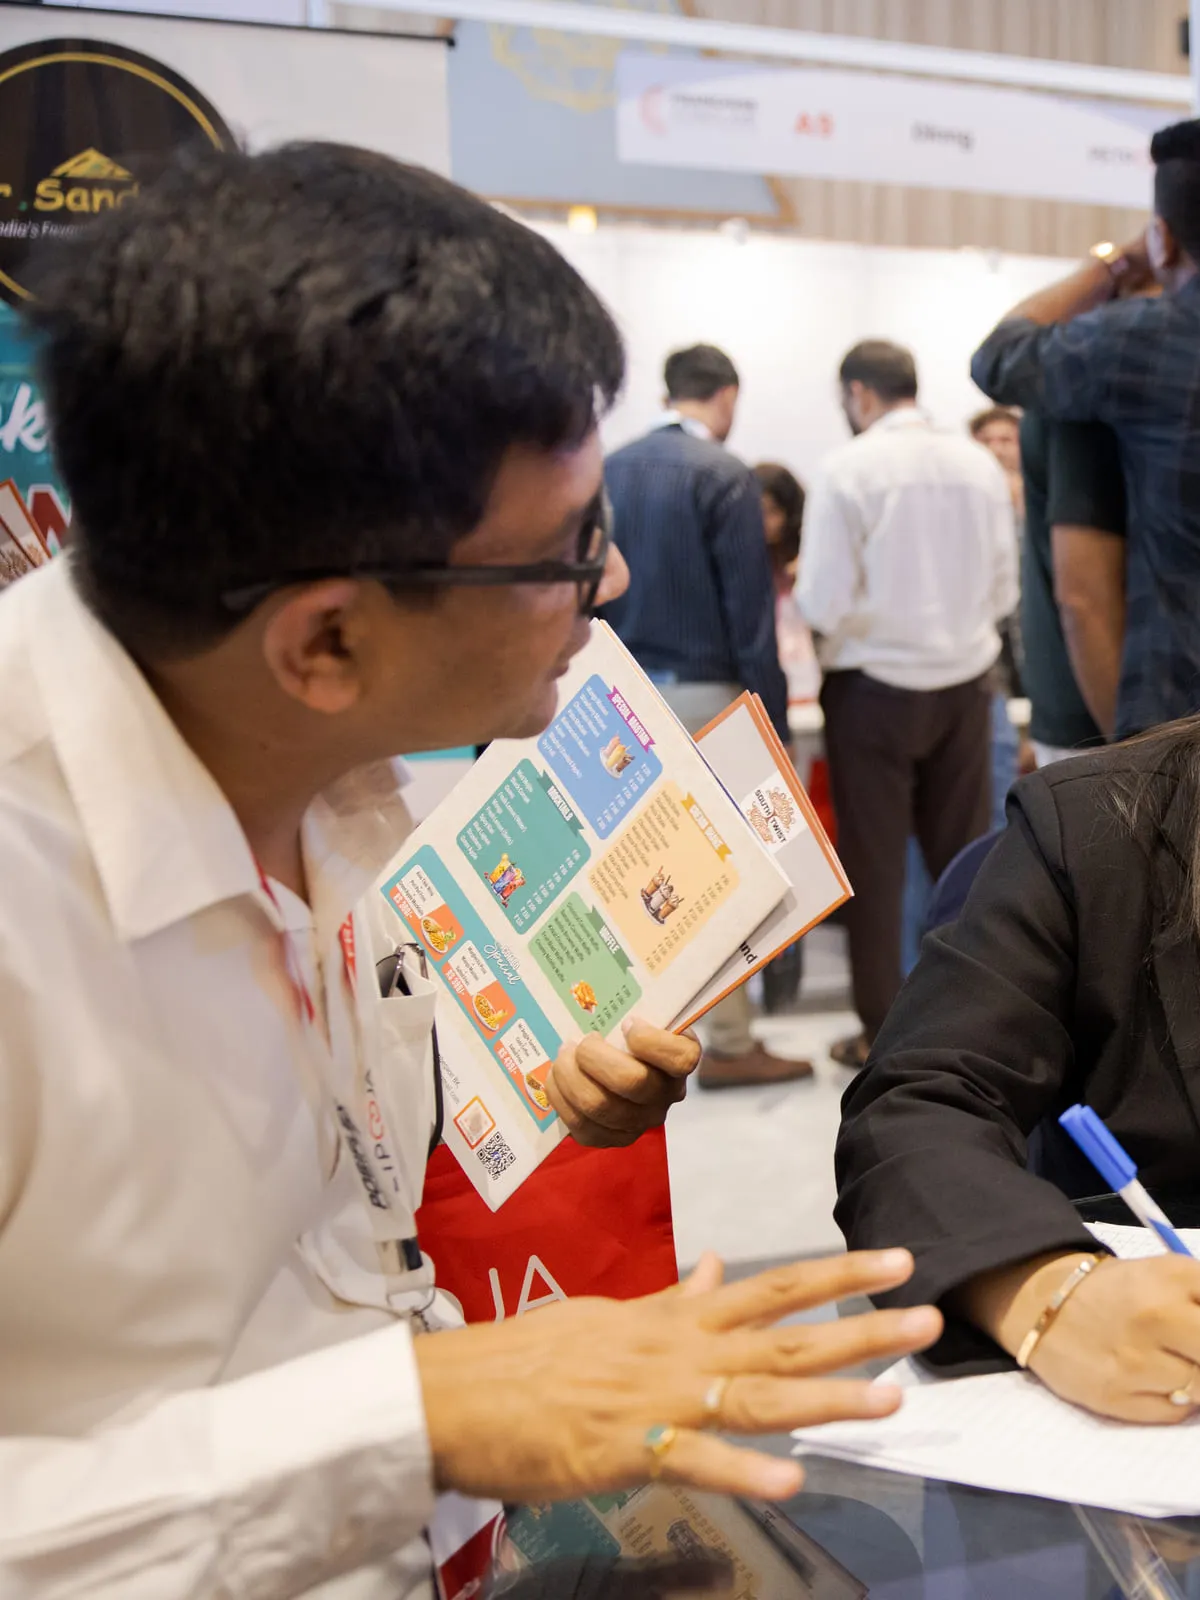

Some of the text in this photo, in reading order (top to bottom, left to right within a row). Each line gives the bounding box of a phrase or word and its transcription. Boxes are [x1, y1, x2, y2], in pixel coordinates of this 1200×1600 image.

[611, 692, 632, 720] SPECIAL
[546, 785, 573, 821] MOCKTAILS
[755, 789, 772, 816] SOUTH
[770, 818, 786, 843] TWIST
[598, 925, 619, 954] WAFFLE
[484, 944, 521, 985] Special
